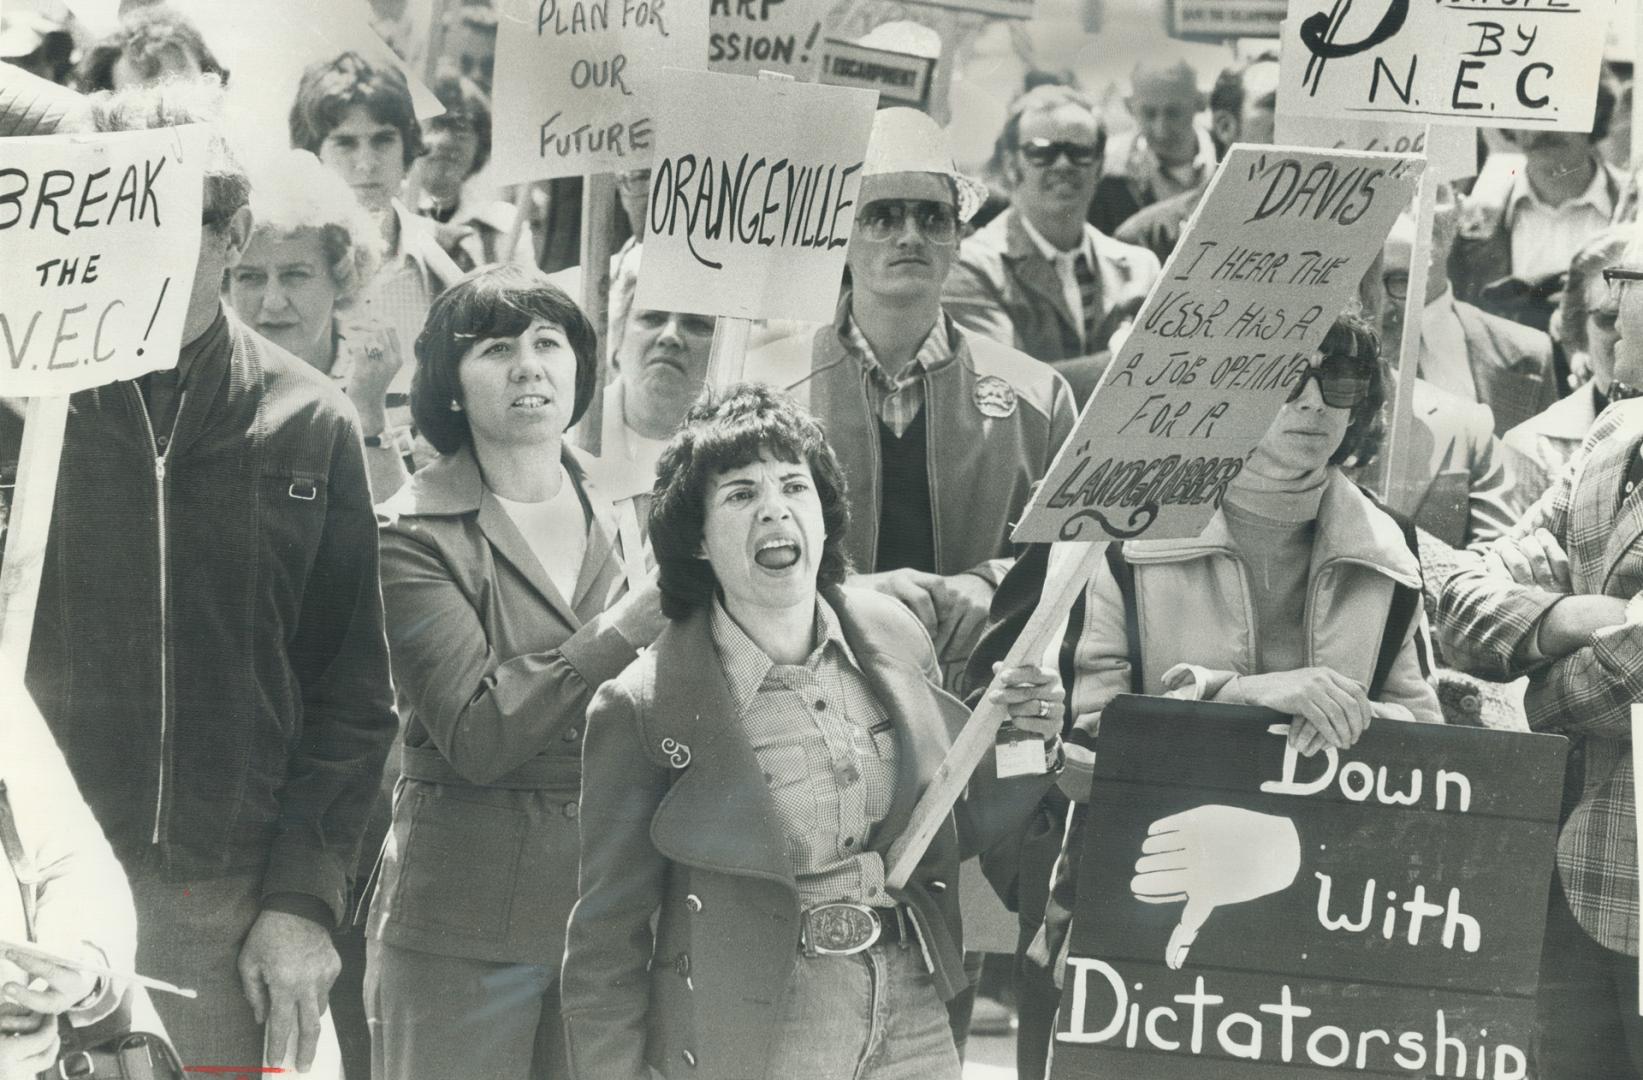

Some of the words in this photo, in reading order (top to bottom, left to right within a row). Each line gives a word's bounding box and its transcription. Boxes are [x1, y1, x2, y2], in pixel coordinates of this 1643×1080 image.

[538, 0, 608, 36] PLAN
[622, 0, 669, 37] FOR
[1460, 21, 1538, 56] BY
[570, 54, 632, 95] OUR
[540, 112, 652, 157] FUTURE
[0, 156, 166, 236] BREAK
[651, 153, 864, 270] ORANGEVILLE
[36, 254, 101, 287] THE
[1174, 241, 1217, 281] I
[1211, 246, 1289, 284] HEAR
[1289, 250, 1350, 286] THE
[1282, 305, 1324, 341] A
[1109, 352, 1144, 387] A
[1145, 351, 1207, 386] JOB
[1117, 393, 1191, 438] FOR
[1189, 401, 1229, 438] A
[1260, 723, 1472, 812] Down
[1315, 871, 1482, 953] With
[1056, 956, 1527, 1080] Dictatorship
